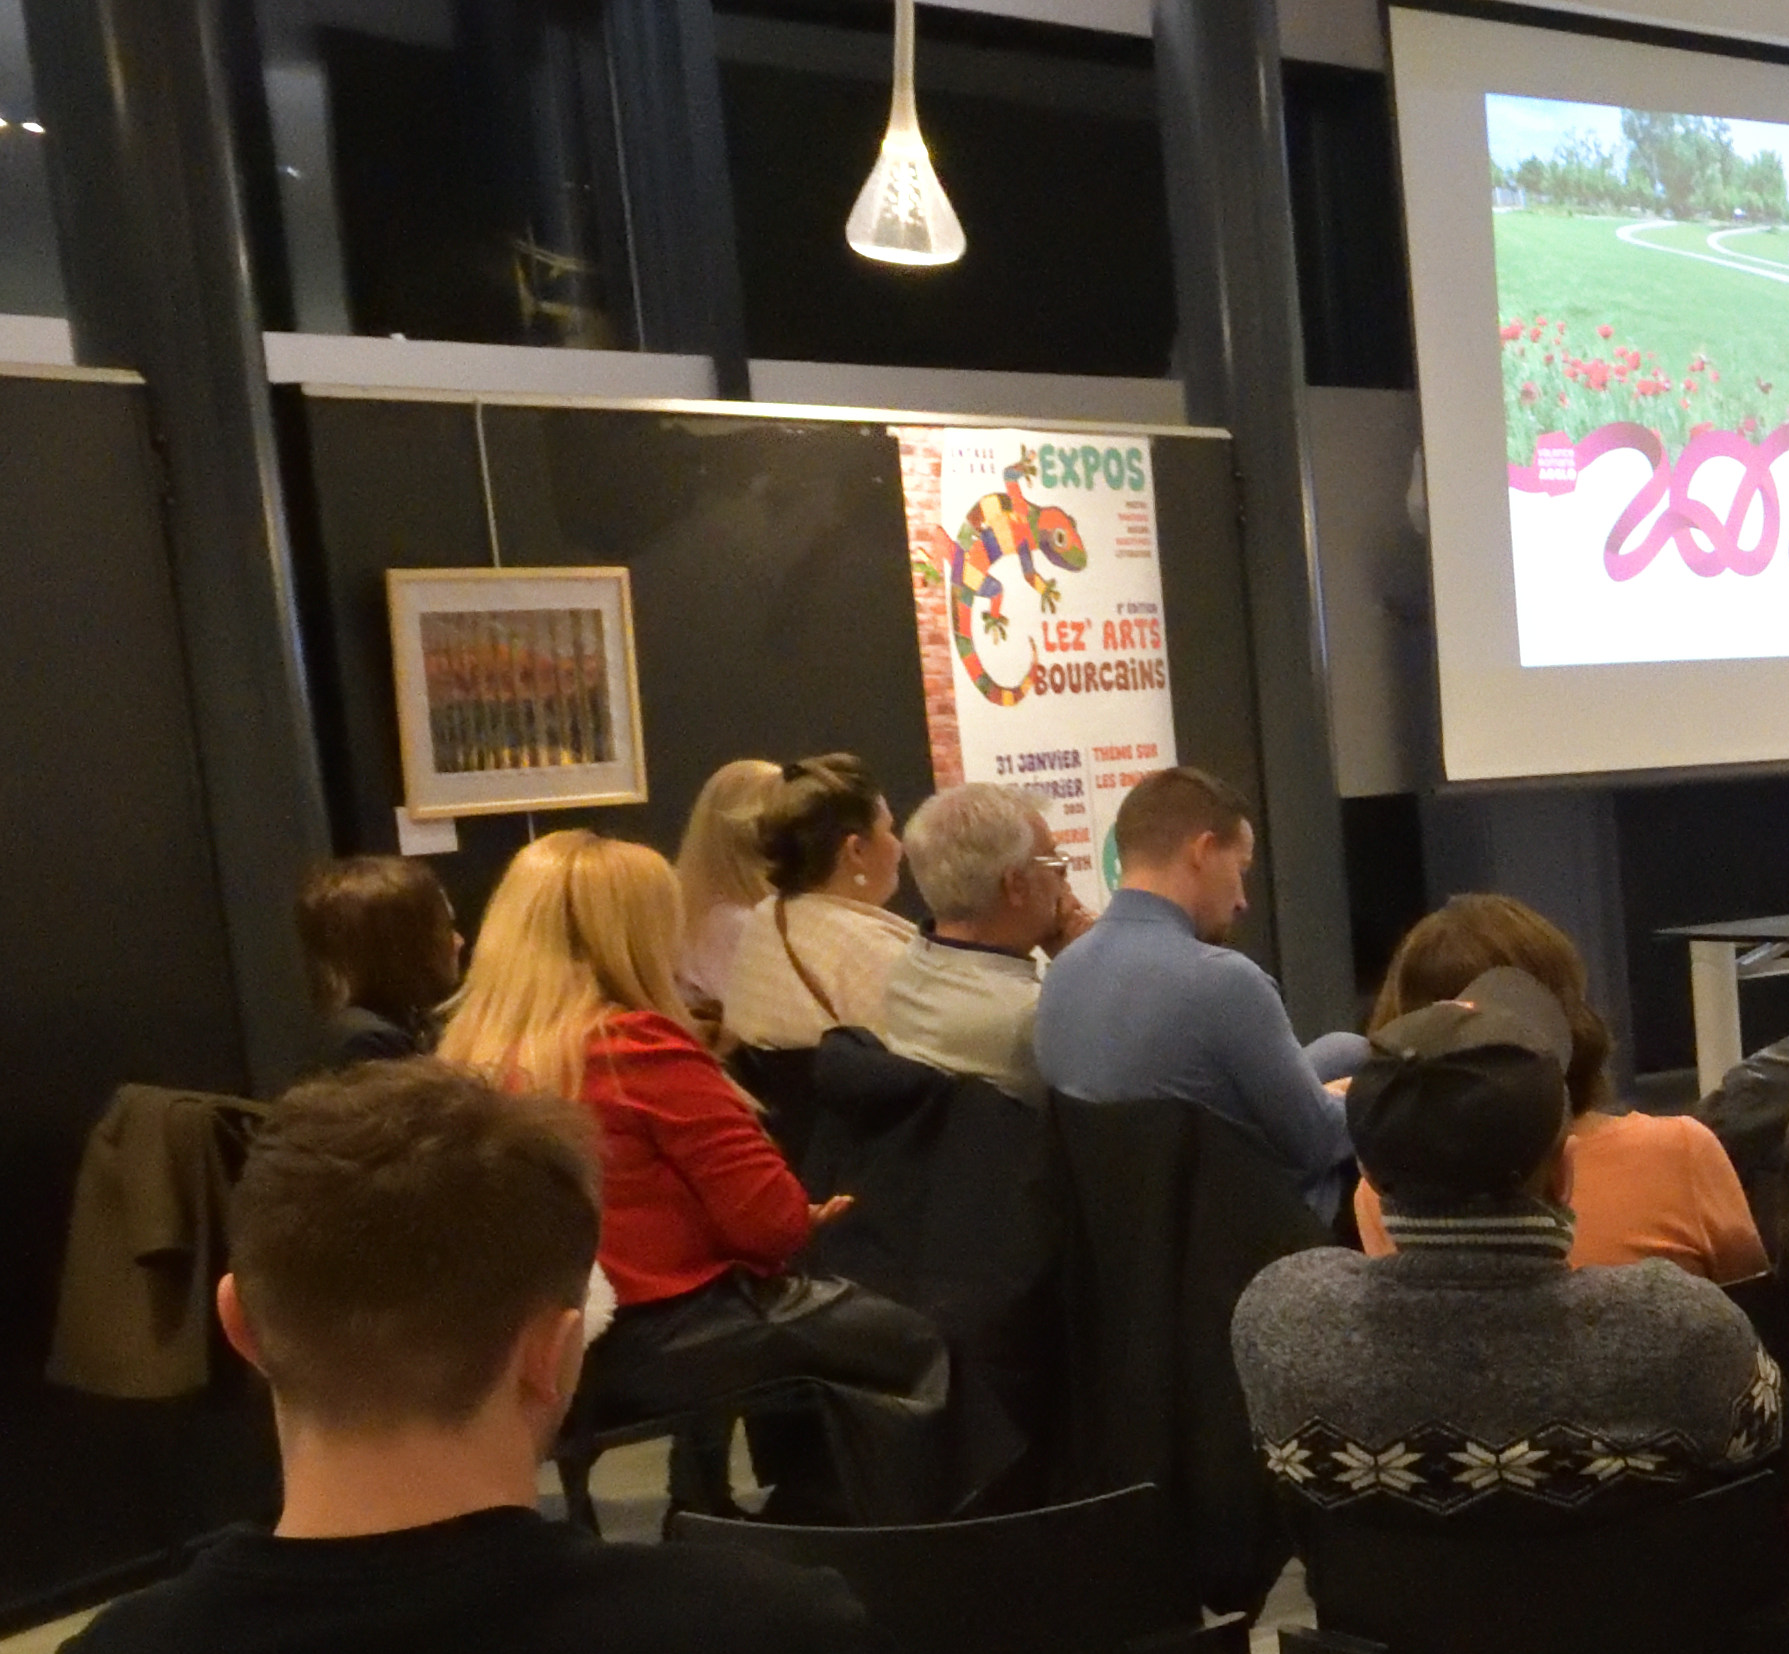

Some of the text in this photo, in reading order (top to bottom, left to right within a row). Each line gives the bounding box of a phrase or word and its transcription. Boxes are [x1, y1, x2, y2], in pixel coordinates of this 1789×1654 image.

[1039, 443, 1145, 491] EXPOS
[1103, 617, 1161, 651] ARTS
[996, 754, 1014, 775] 31
[1095, 773, 1117, 789] LES
